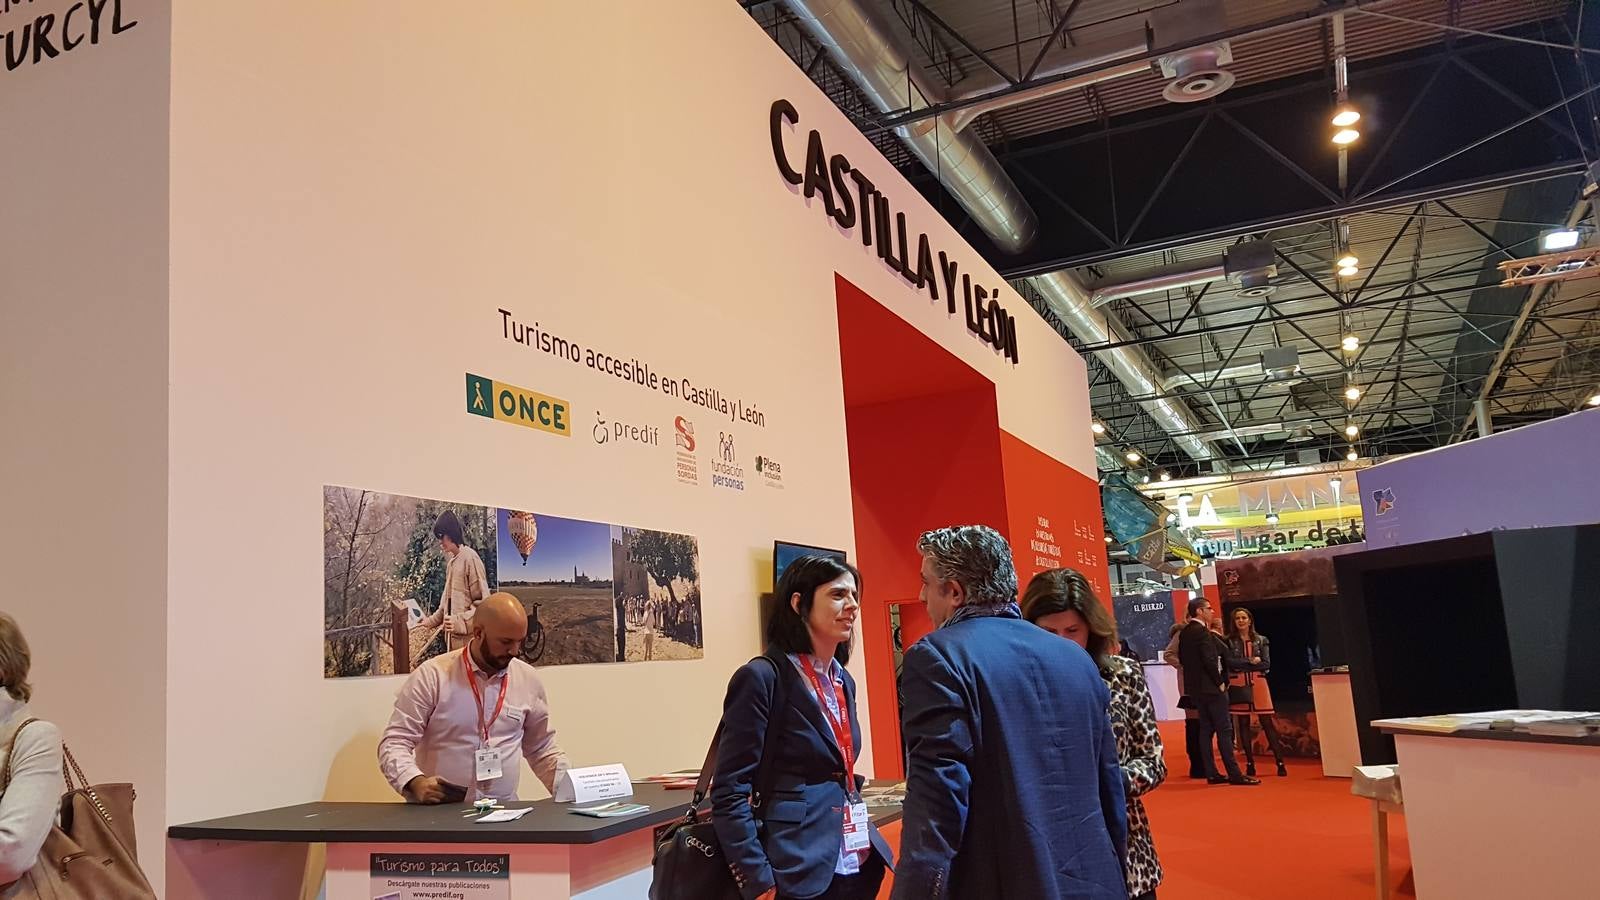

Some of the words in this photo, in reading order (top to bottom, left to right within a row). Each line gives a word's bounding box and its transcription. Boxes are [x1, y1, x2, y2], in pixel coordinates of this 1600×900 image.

[0, 0, 138, 71] URCYL
[770, 99, 939, 300] CASTILLA
[938, 251, 958, 314] Y
[962, 273, 1018, 364] LEÓN
[498, 308, 580, 363] Turismo
[586, 349, 658, 390] accesible
[662, 377, 679, 398] en
[682, 378, 728, 415] Castilla
[730, 401, 737, 422] y
[739, 400, 765, 428] León
[499, 389, 566, 430] ONCE
[614, 421, 659, 446] predif
[711, 458, 744, 479] fundación
[763, 457, 781, 473] Plena
[712, 474, 745, 491] personas
[1235, 528, 1299, 553] lugar
[1308, 519, 1341, 542] de
[430, 861, 460, 876] para
[387, 879, 420, 888] Descárgale
[448, 881, 490, 889] publicaciones
[412, 891, 464, 899] www.predif.org
